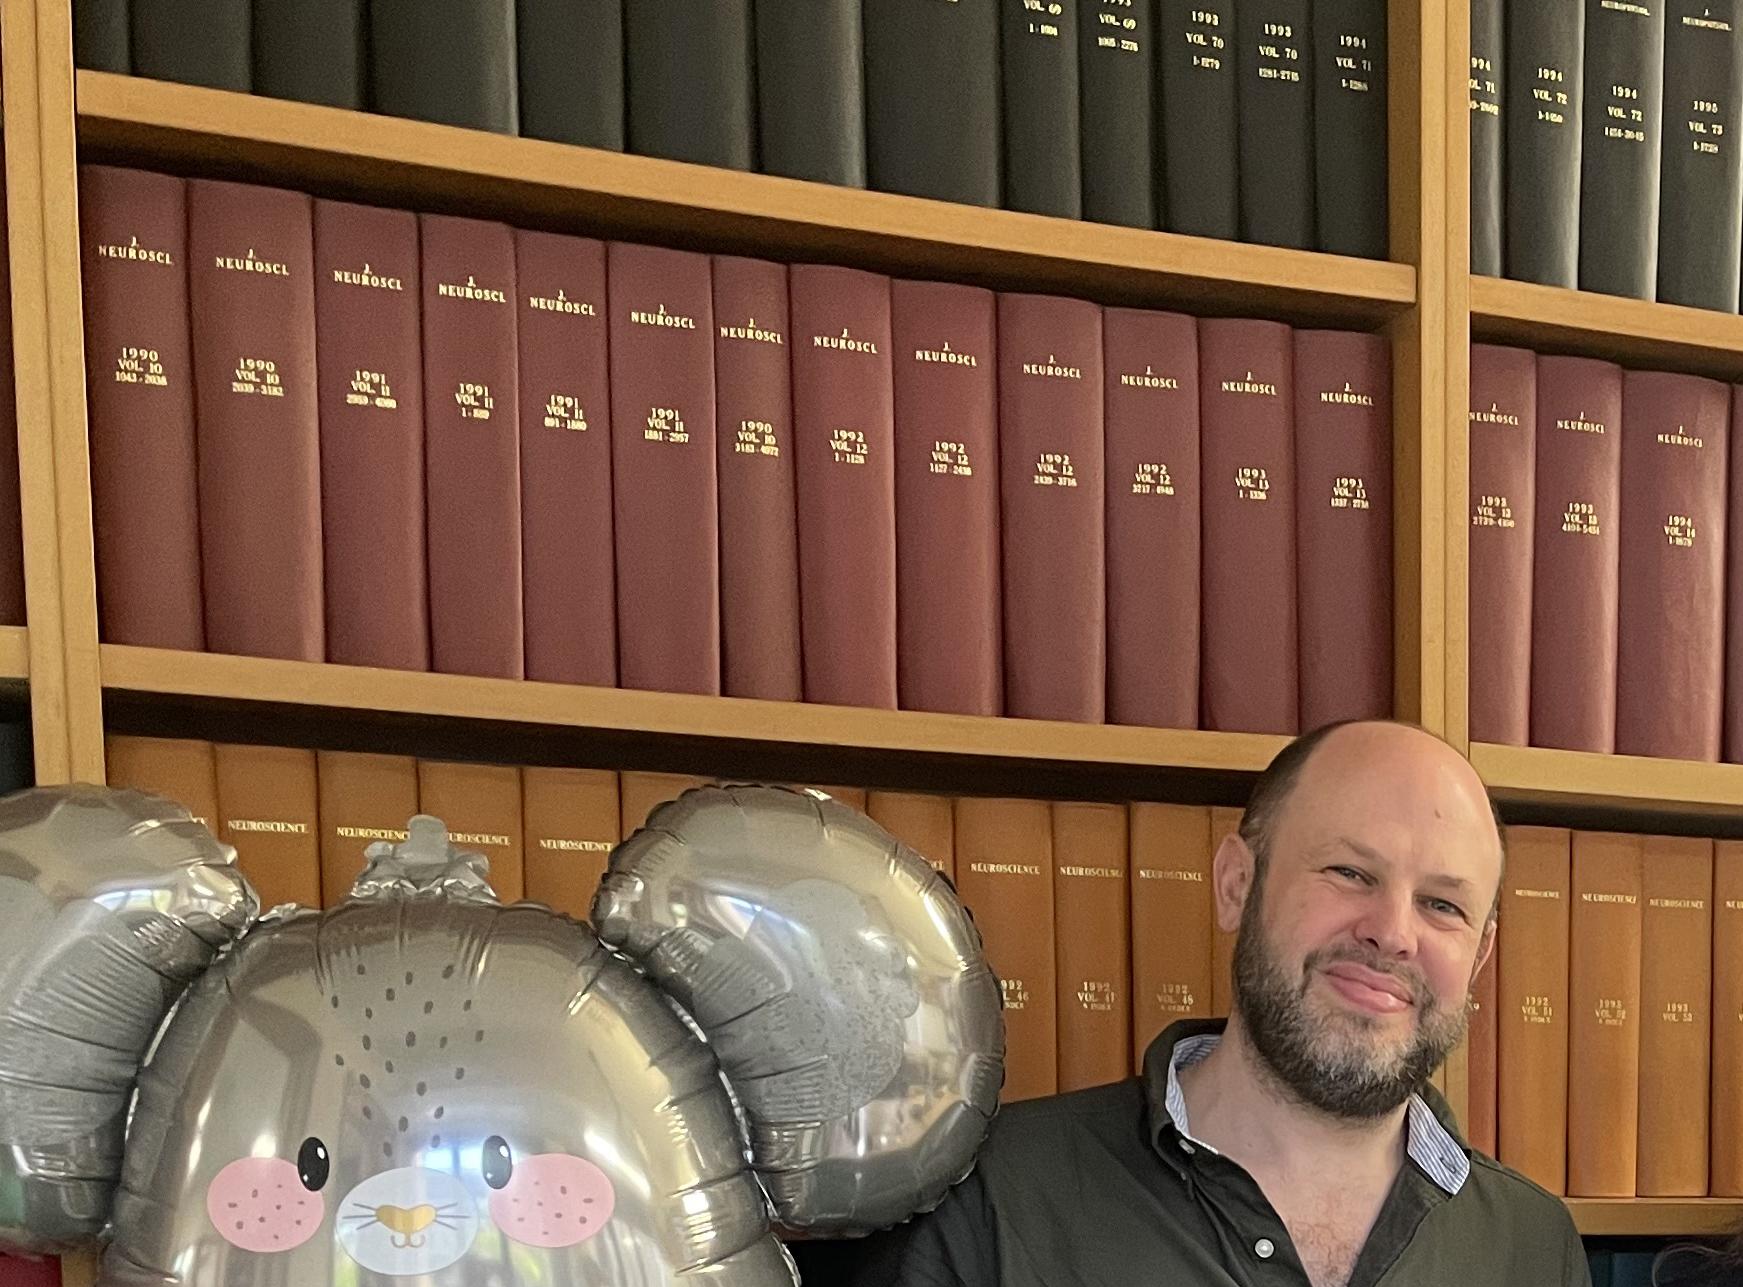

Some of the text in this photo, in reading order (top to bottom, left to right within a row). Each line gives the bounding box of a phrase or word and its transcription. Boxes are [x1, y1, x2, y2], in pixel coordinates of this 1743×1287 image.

[1192, 10, 1219, 26] 1993
[1264, 23, 1292, 37] 1993
[1340, 35, 1366, 49] 1994
[1538, 67, 1563, 82] 1994
[1612, 85, 1637, 99] 1994
[122, 347, 158, 362] 1990
[149, 362, 163, 374] 10
[240, 358, 275, 373] 1990
[266, 373, 280, 385] 10
[356, 370, 386, 385] 1991
[381, 385, 390, 396] 11
[459, 383, 489, 397] 1991
[484, 397, 494, 409] 11
[551, 395, 579, 408] 1991
[574, 408, 584, 420] 11
[651, 408, 680, 421] 1991
[674, 420, 684, 432] 11
[741, 421, 773, 434] 1990
[764, 434, 776, 445] 10
[834, 429, 864, 443] 1992
[856, 443, 868, 454] 12
[935, 441, 965, 454] 1992
[957, 454, 969, 465] 12
[1040, 453, 1069, 465] 1992
[1062, 465, 1074, 476] 12
[1138, 463, 1167, 475] 1992
[1238, 468, 1266, 479] 1993
[1159, 474, 1171, 485] 12
[1259, 479, 1270, 490] 13
[1336, 478, 1363, 489] 1993
[1356, 489, 1366, 499] 13
[228, 819, 308, 834] NEUROSCIENCE
[336, 827, 410, 840] NEUROSCIENC
[449, 832, 511, 846] UROSCIENCE
